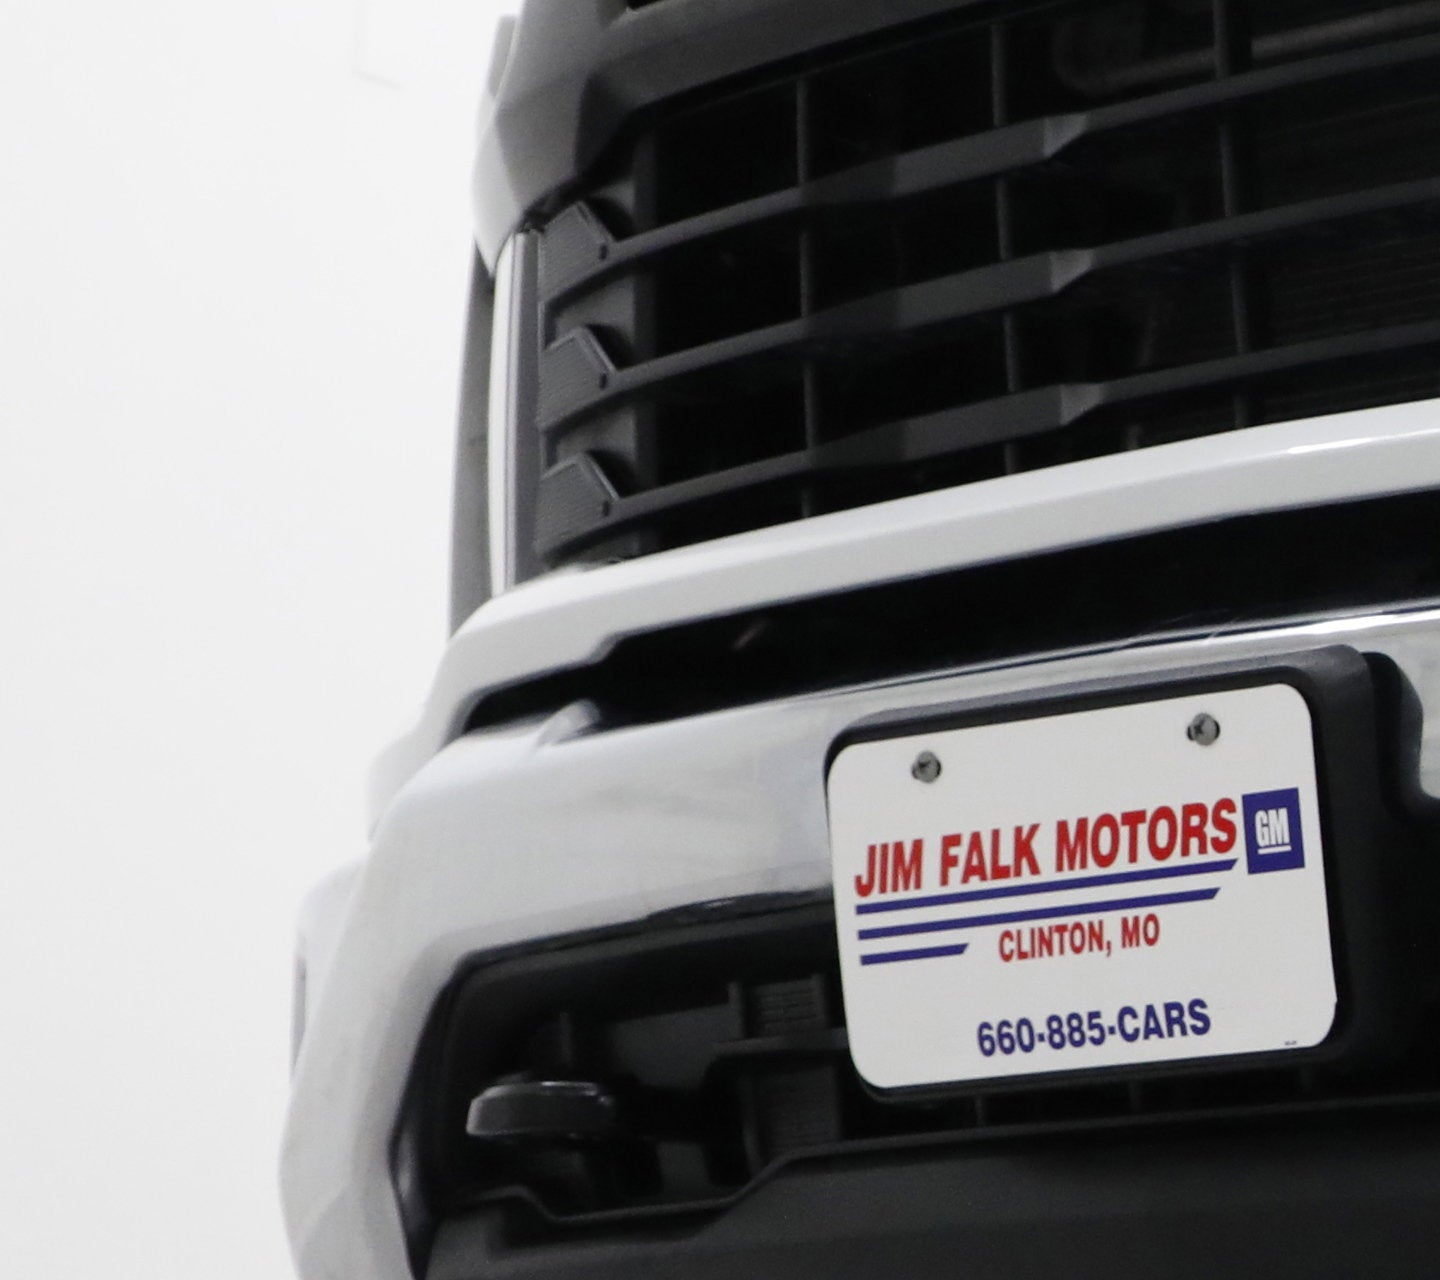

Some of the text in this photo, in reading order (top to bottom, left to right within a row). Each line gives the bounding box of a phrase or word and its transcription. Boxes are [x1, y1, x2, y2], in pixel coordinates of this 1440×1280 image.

[854, 797, 1238, 898] JIM FALK MOTORS
[1254, 806, 1291, 849] GM
[998, 913, 1161, 963] CLINTON, MO
[977, 998, 1212, 1057] 660-885-CARS
